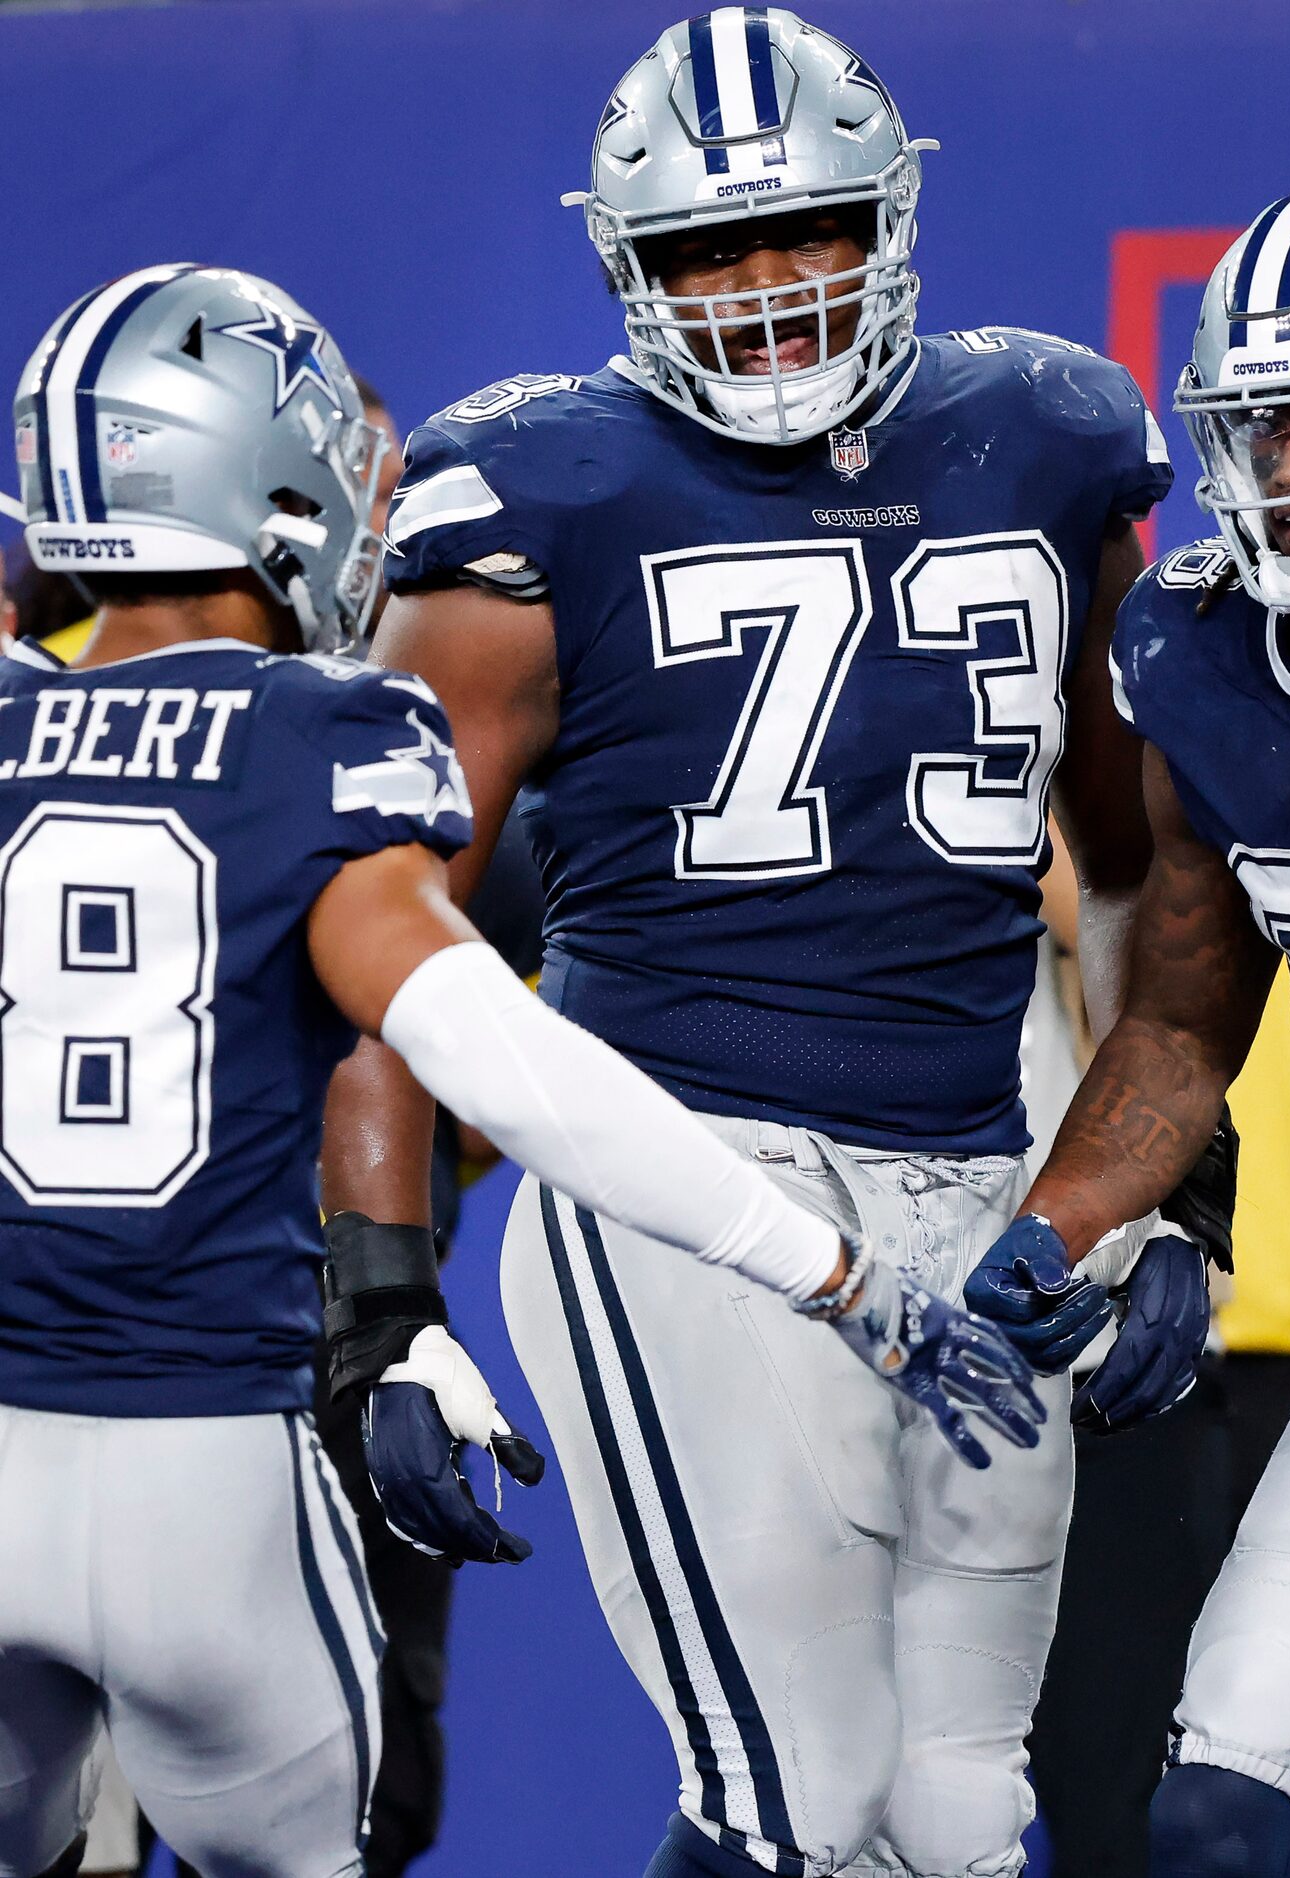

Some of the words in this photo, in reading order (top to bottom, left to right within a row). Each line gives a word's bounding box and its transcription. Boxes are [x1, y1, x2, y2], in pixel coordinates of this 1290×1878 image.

[717, 177, 782, 197] COWBOYS
[1233, 360, 1289, 376] COWBOYS
[837, 447, 864, 468] NFL
[812, 504, 920, 528] COWBOYS
[640, 529, 1069, 880] 73
[0, 687, 252, 781] BERT
[0, 800, 219, 1208] 8
